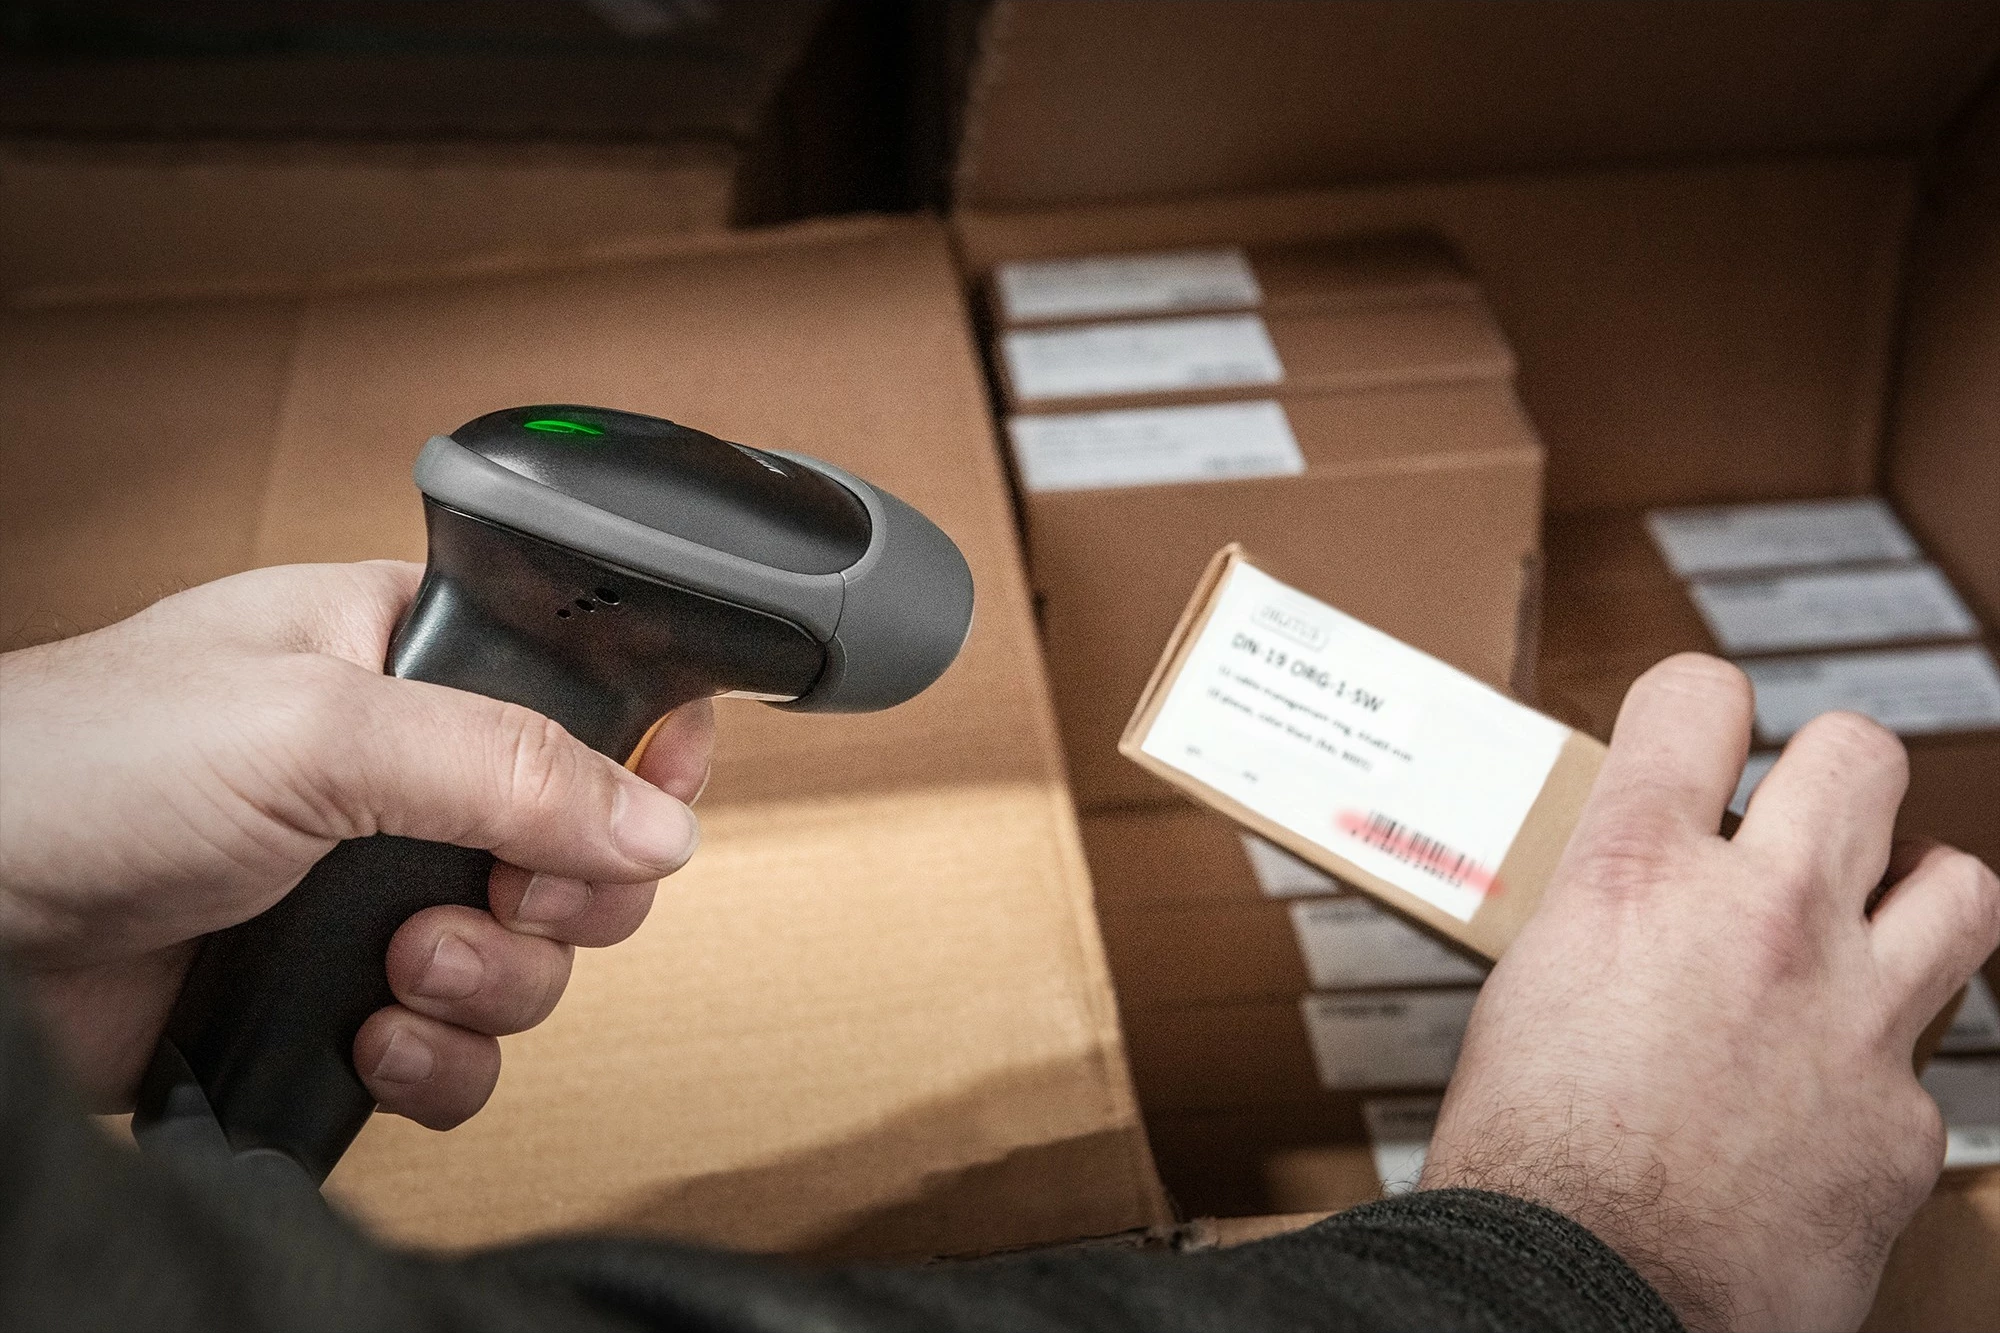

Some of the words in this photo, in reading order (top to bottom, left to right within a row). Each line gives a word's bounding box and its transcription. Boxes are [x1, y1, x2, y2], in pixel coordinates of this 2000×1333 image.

[1232, 633, 1287, 667] DN-19
[1291, 661, 1384, 712] ORG-1-SW
[1262, 687, 1330, 723] management
